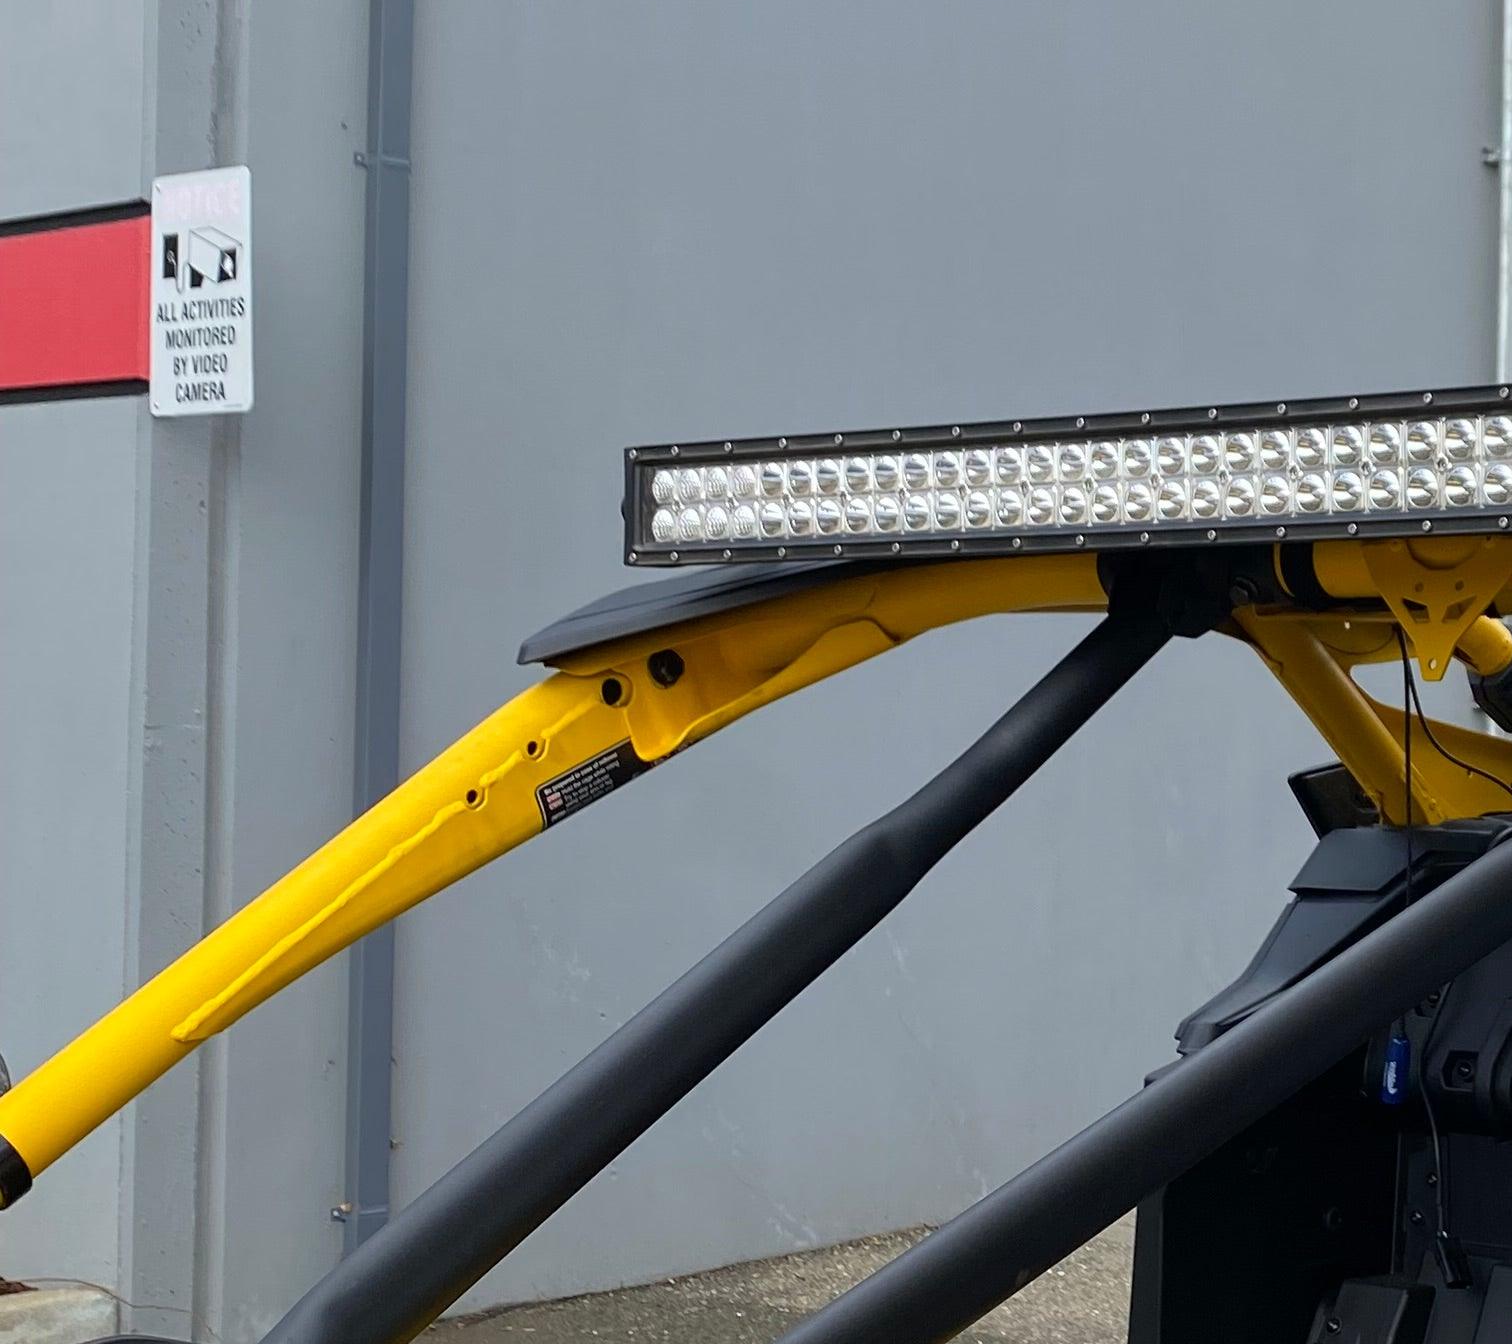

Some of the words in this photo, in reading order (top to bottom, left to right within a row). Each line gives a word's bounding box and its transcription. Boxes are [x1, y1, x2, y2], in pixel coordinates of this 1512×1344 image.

[156, 303, 178, 323] ALL
[181, 297, 245, 320] ACTIVITIES
[165, 326, 236, 349] MONITORED
[173, 357, 188, 376] BY
[191, 353, 228, 375] VIDEO
[175, 380, 227, 404] CAMERA
